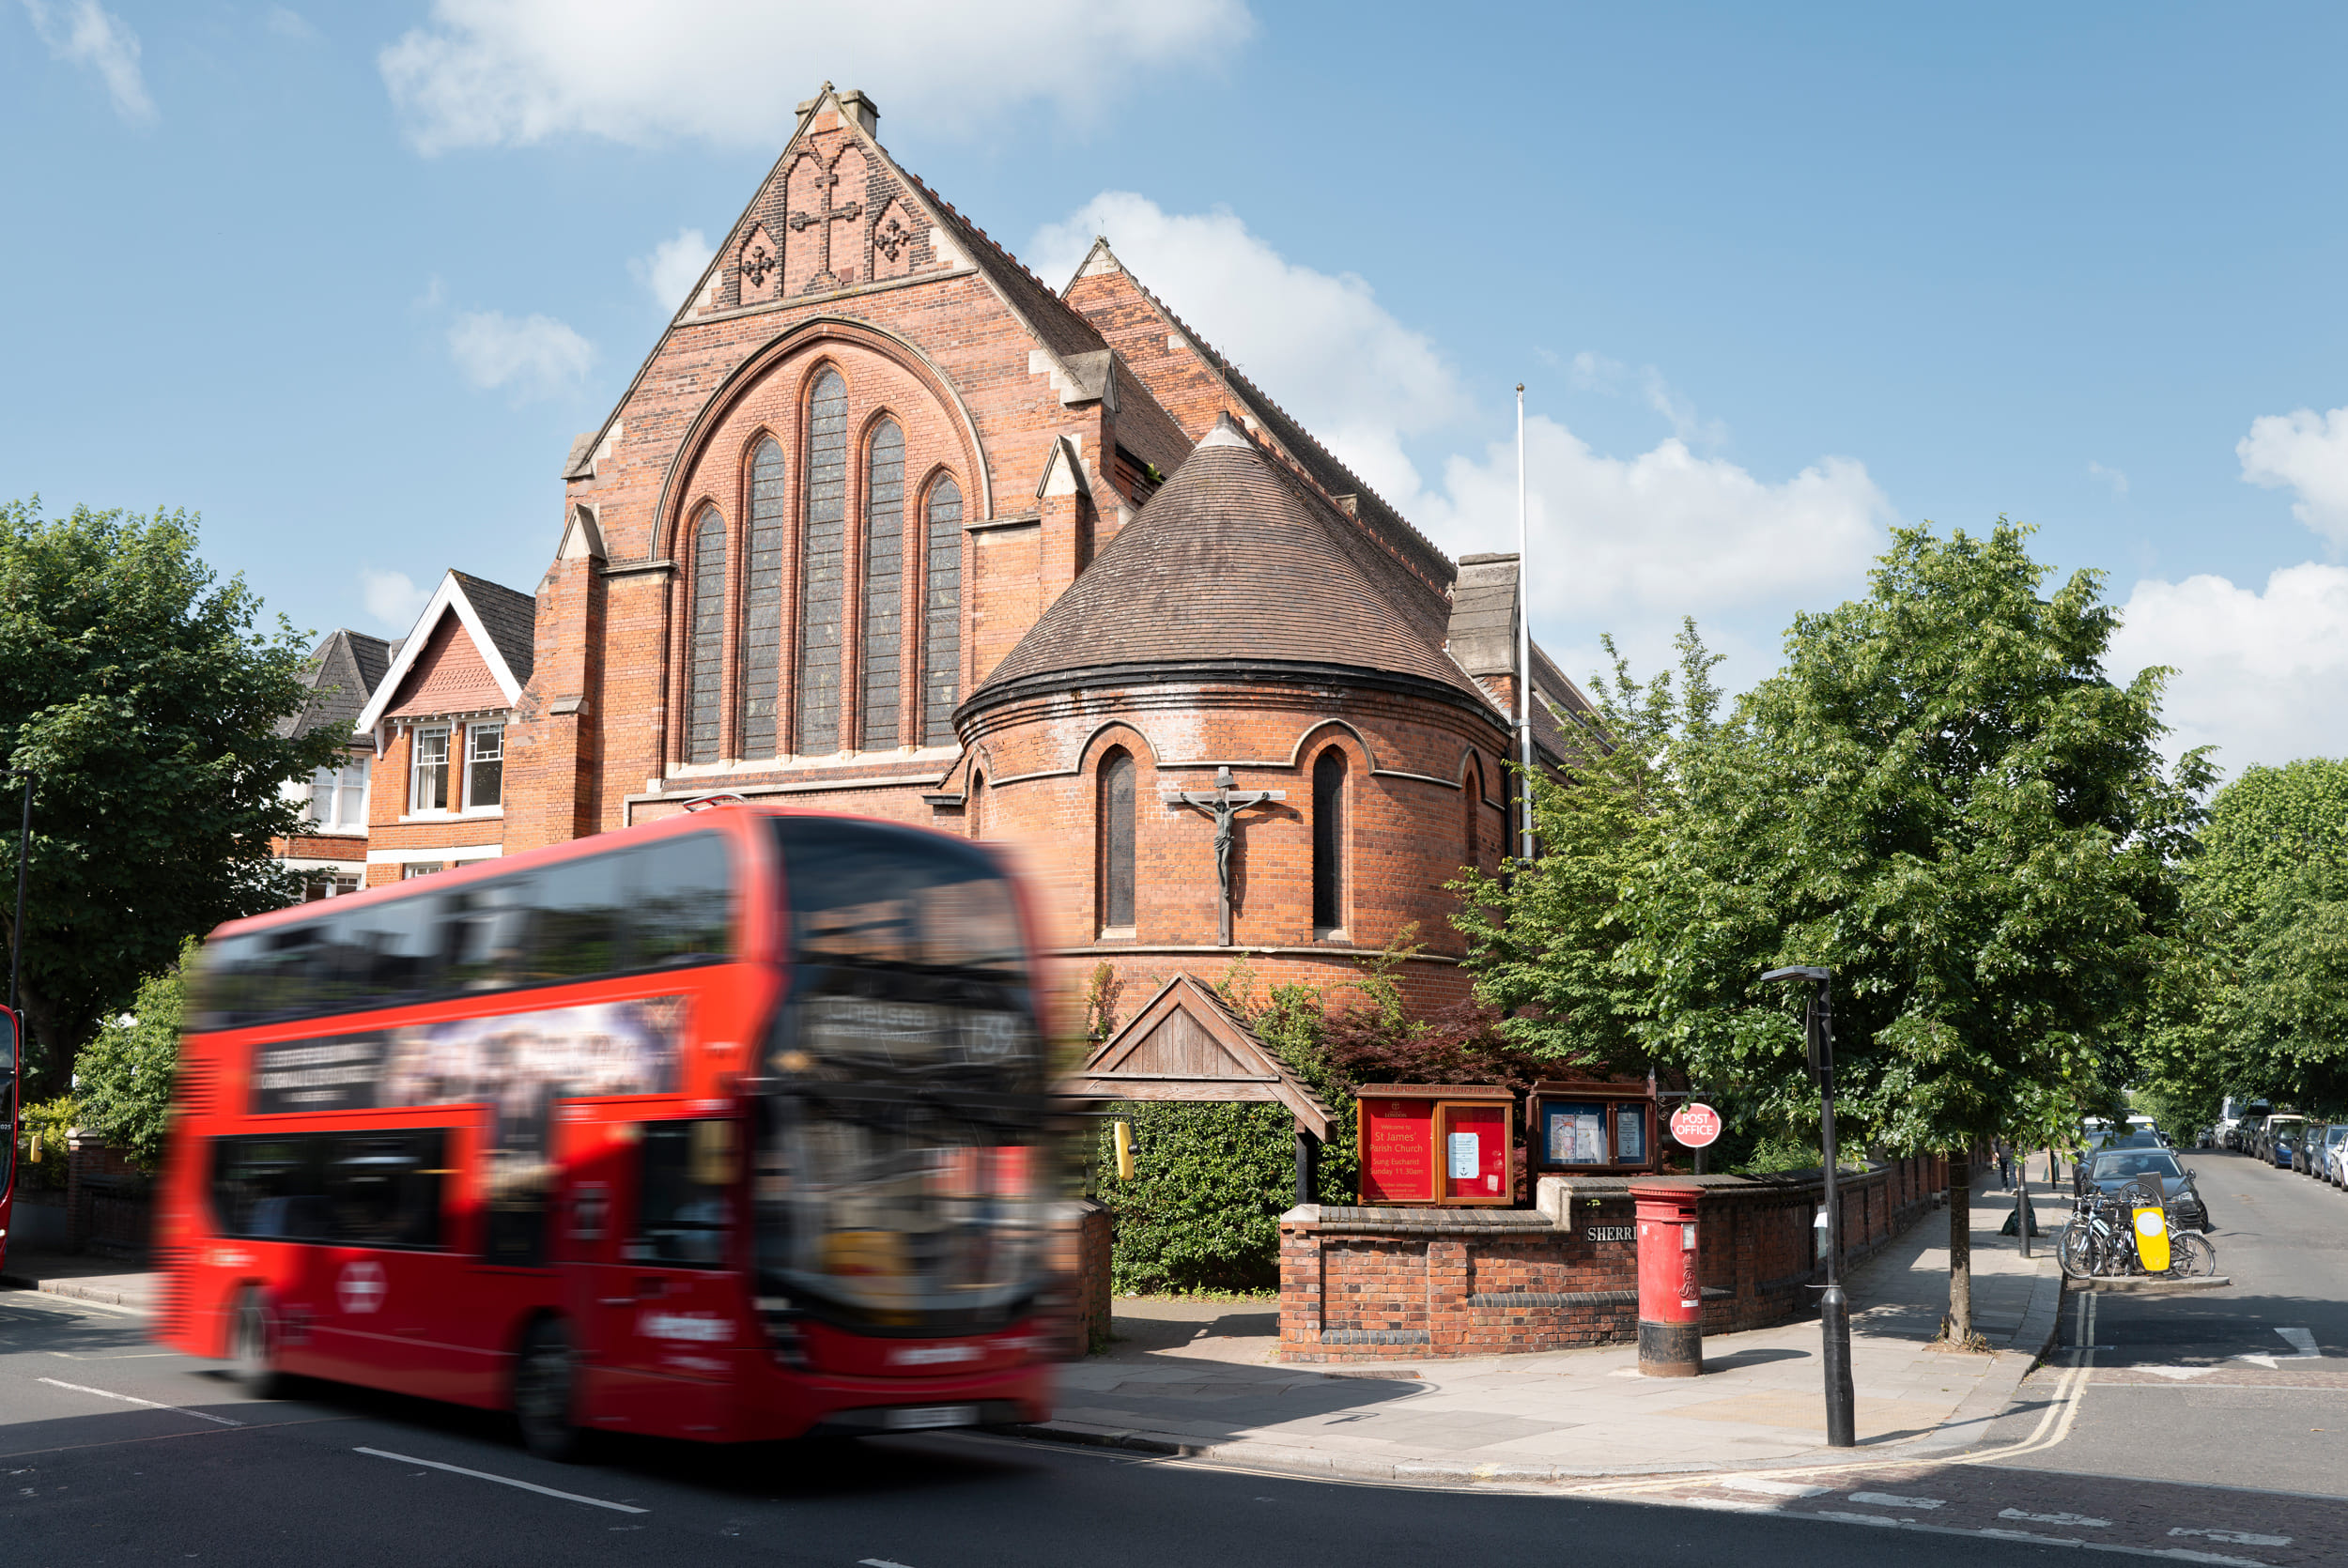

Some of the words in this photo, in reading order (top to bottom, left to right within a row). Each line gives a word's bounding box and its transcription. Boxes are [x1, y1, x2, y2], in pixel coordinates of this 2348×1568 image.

[827, 999, 925, 1026] Chelsea
[1682, 1114, 1709, 1124] POST
[1676, 1125, 1714, 1135] OFFICE
[1375, 1131, 1384, 1141] St
[1386, 1131, 1417, 1142] James'
[1369, 1144, 1392, 1152] Parish
[1395, 1144, 1423, 1153] Church
[1373, 1158, 1390, 1166] Sung
[1370, 1168, 1393, 1176] Sunday
[1587, 1226, 1637, 1241] SHERRI
